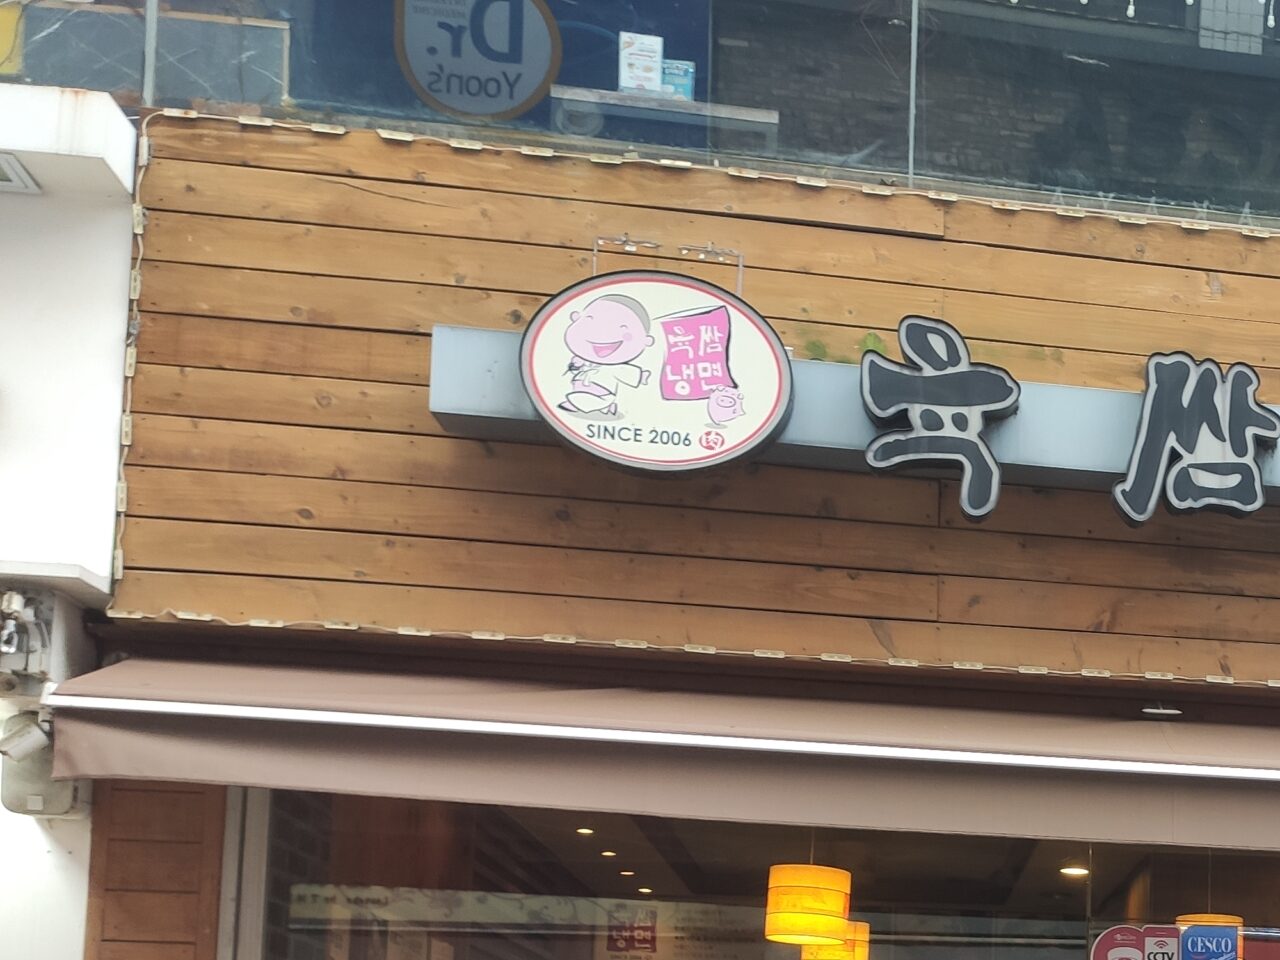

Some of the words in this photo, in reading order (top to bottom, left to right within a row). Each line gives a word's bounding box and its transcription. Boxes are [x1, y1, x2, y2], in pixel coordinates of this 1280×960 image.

[667, 325, 724, 358] 육쌈
[586, 424, 643, 443] SINCE
[649, 430, 692, 447] 2006
[1187, 936, 1232, 954] CESCO
